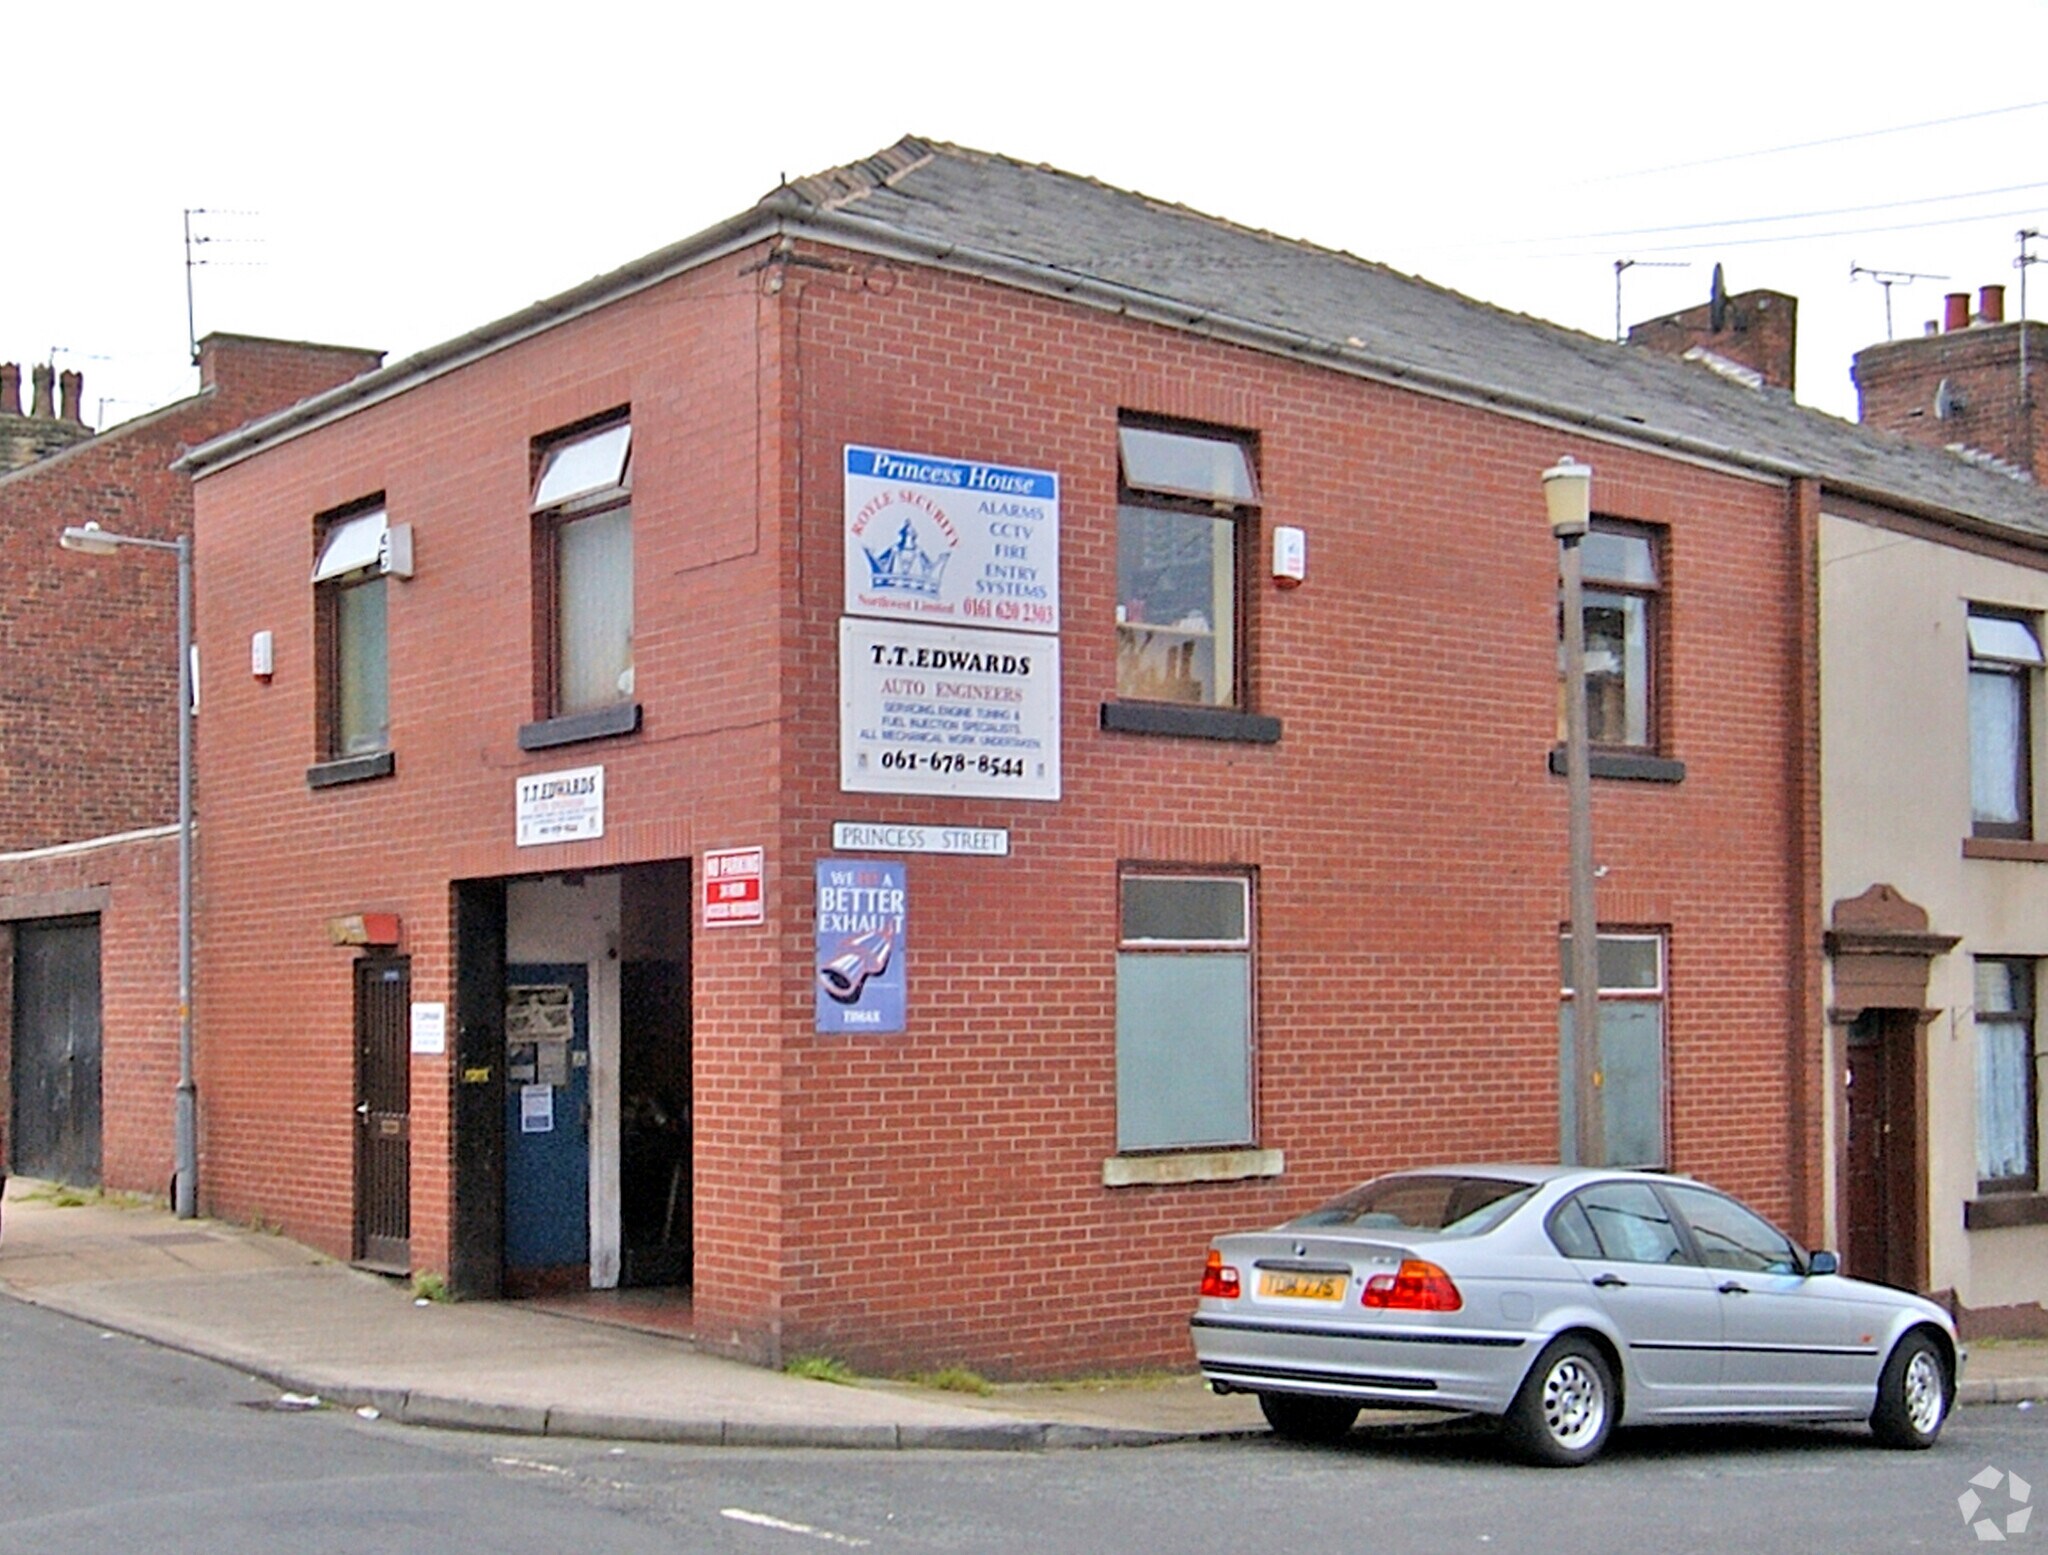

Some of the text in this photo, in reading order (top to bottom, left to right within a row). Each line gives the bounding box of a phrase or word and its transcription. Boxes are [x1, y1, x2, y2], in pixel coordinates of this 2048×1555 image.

[872, 453, 1035, 494] Princess House
[851, 490, 959, 548] ROYLE SECURITY
[979, 501, 1044, 520] ALARMS
[989, 521, 1034, 539] CCTV
[995, 543, 1028, 560] FIRE
[985, 563, 1038, 581] ENTRY
[976, 579, 1047, 600] SYSTEMS
[963, 596, 991, 618] 0161
[871, 645, 1032, 676] T.T.EDWARDS
[881, 679, 1023, 701] AUTO ENGINEERS
[882, 716, 905, 728] FUEL
[910, 718, 959, 730] INJECTION
[860, 729, 876, 740] ALL
[881, 749, 1024, 777] 061-678-8544
[842, 826, 1000, 850] PRINCESS STREET
[831, 871, 853, 887] WE
[882, 873, 894, 887] A
[821, 887, 904, 914] BETTER
[820, 913, 904, 934] EXHAUT
